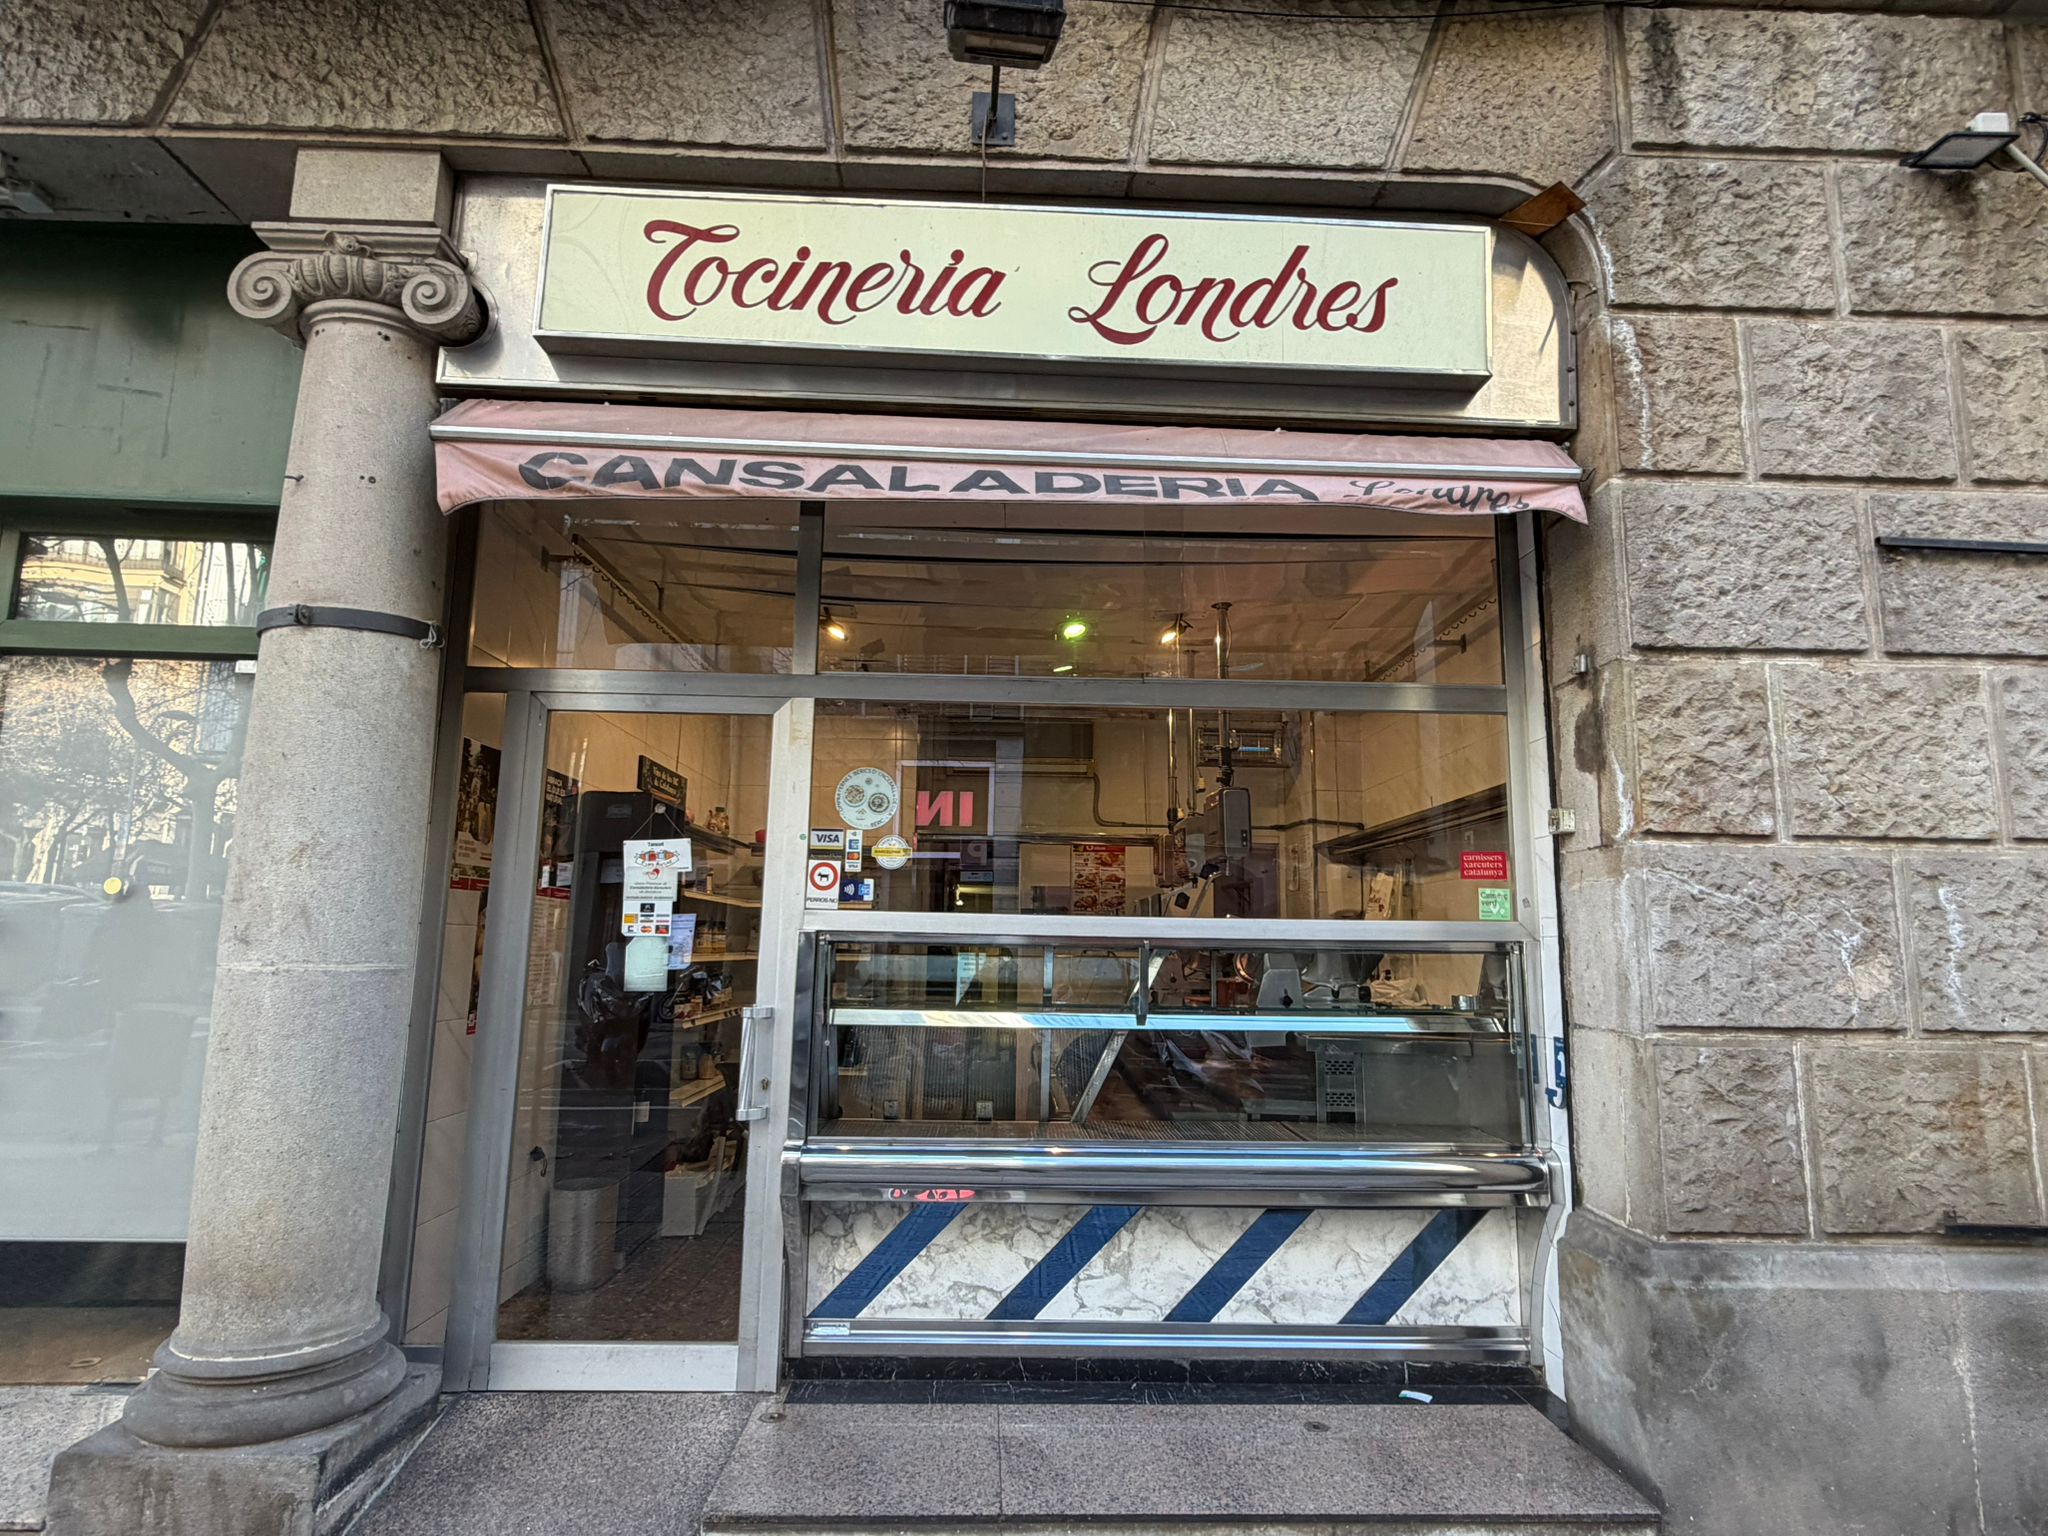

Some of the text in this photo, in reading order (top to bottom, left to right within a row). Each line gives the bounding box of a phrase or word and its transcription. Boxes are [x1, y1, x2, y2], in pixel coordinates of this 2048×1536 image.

[644, 219, 1399, 345] Tocineria Londres
[518, 451, 1320, 503] CANSALADERIA
[816, 833, 840, 843] VISA
[1464, 869, 1503, 877] catalunya
